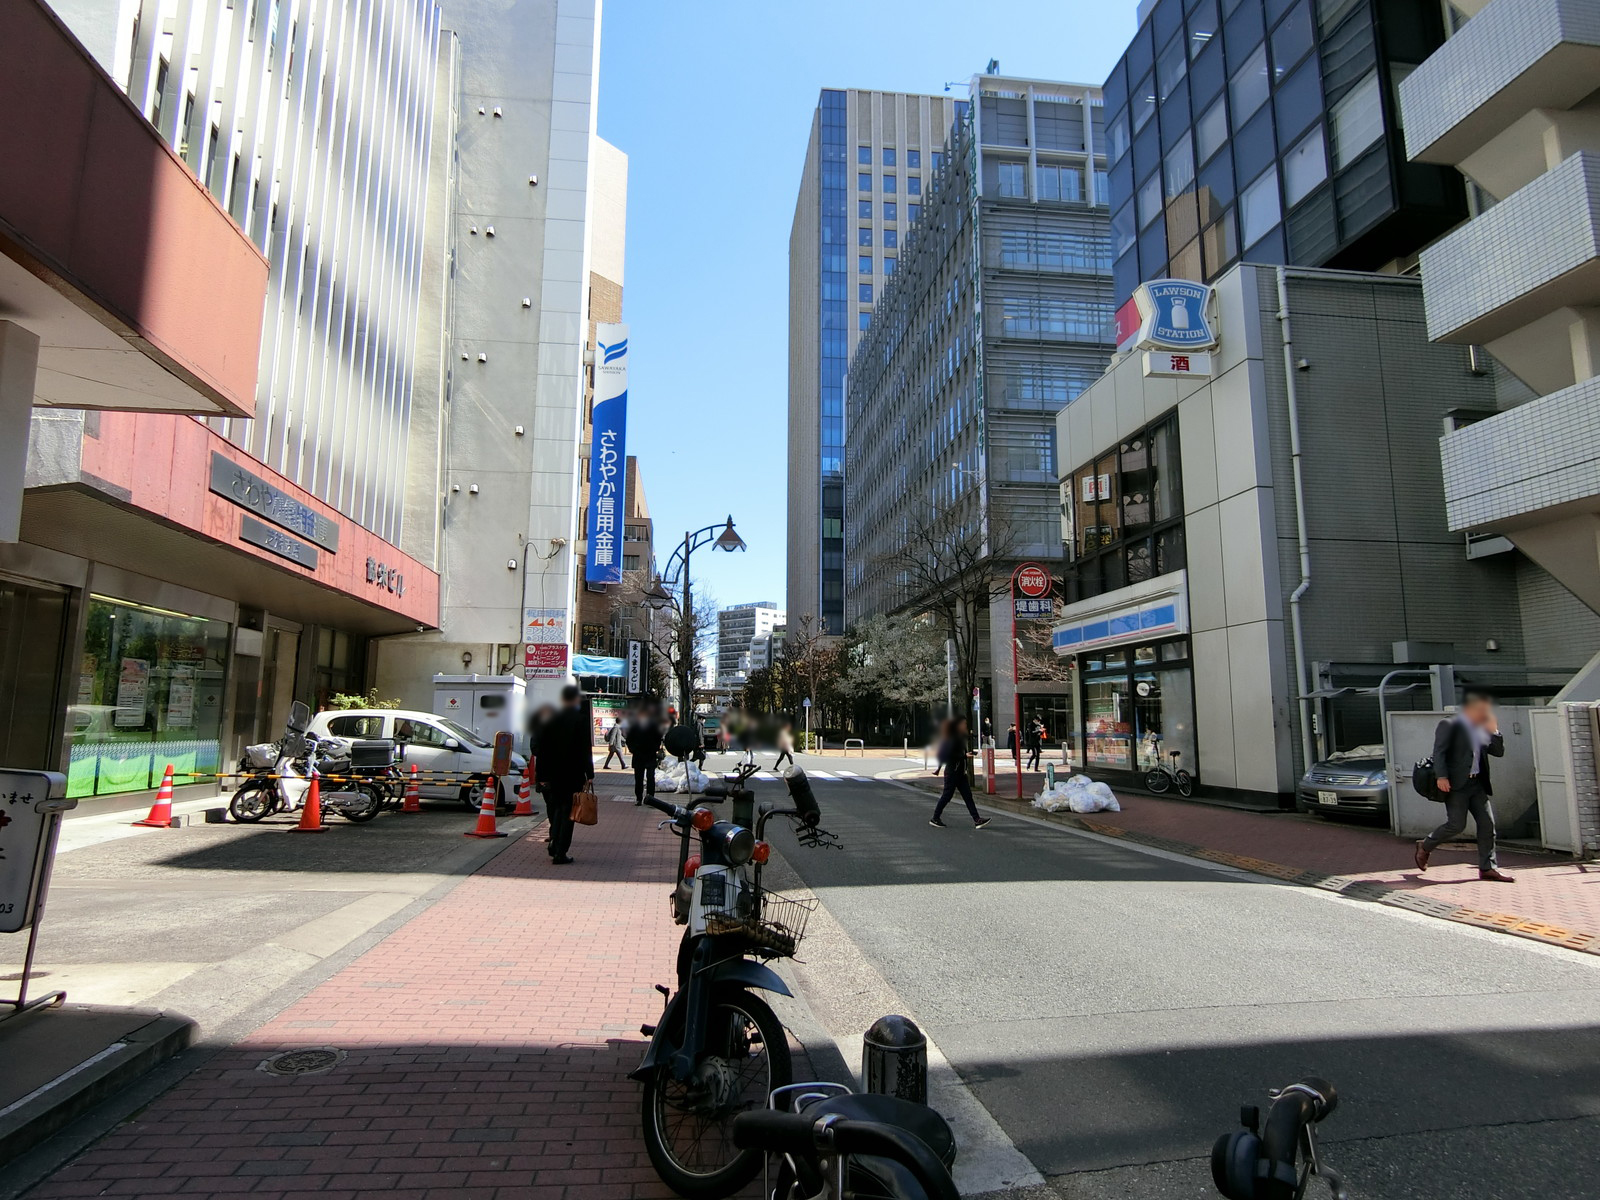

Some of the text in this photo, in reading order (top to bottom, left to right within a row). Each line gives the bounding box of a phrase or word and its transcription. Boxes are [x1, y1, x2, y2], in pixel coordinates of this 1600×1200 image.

[1154, 287, 1202, 299] LAWSON
[1157, 326, 1205, 339] STATION
[1170, 355, 1190, 371] 酒
[594, 429, 618, 567] さわやか信用金庫
[1021, 576, 1044, 587] 消火栓
[1015, 600, 1052, 612] 堤歯科
